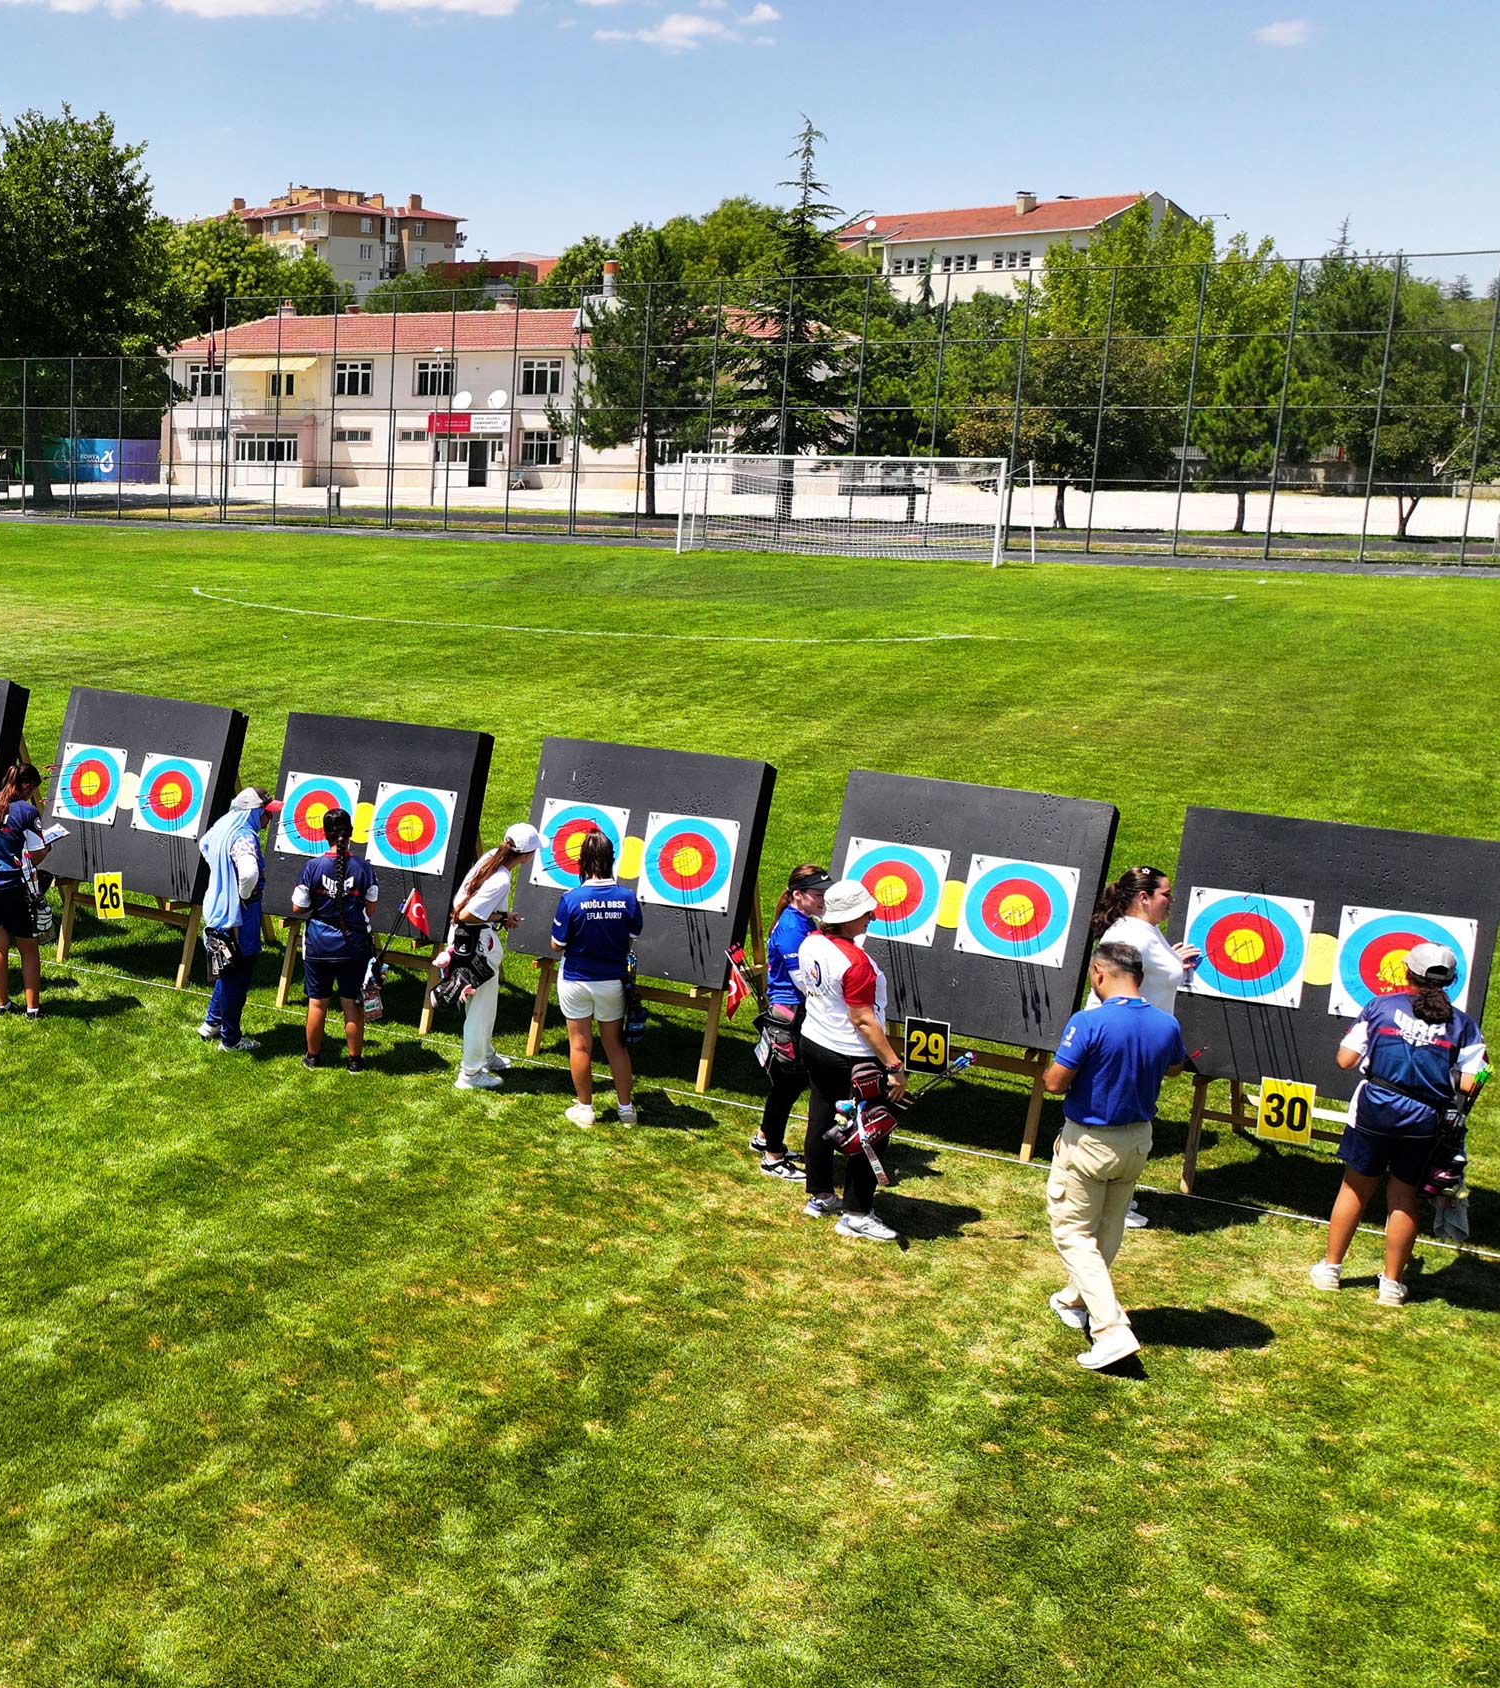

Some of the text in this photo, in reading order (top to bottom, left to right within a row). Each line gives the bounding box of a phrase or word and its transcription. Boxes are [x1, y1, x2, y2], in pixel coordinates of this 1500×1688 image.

[98, 882, 120, 910] 26
[580, 898, 627, 910] MUĞLA BBSK
[604, 911, 622, 920] DURU
[909, 1030, 946, 1066] 29
[1264, 1092, 1308, 1132] 30
